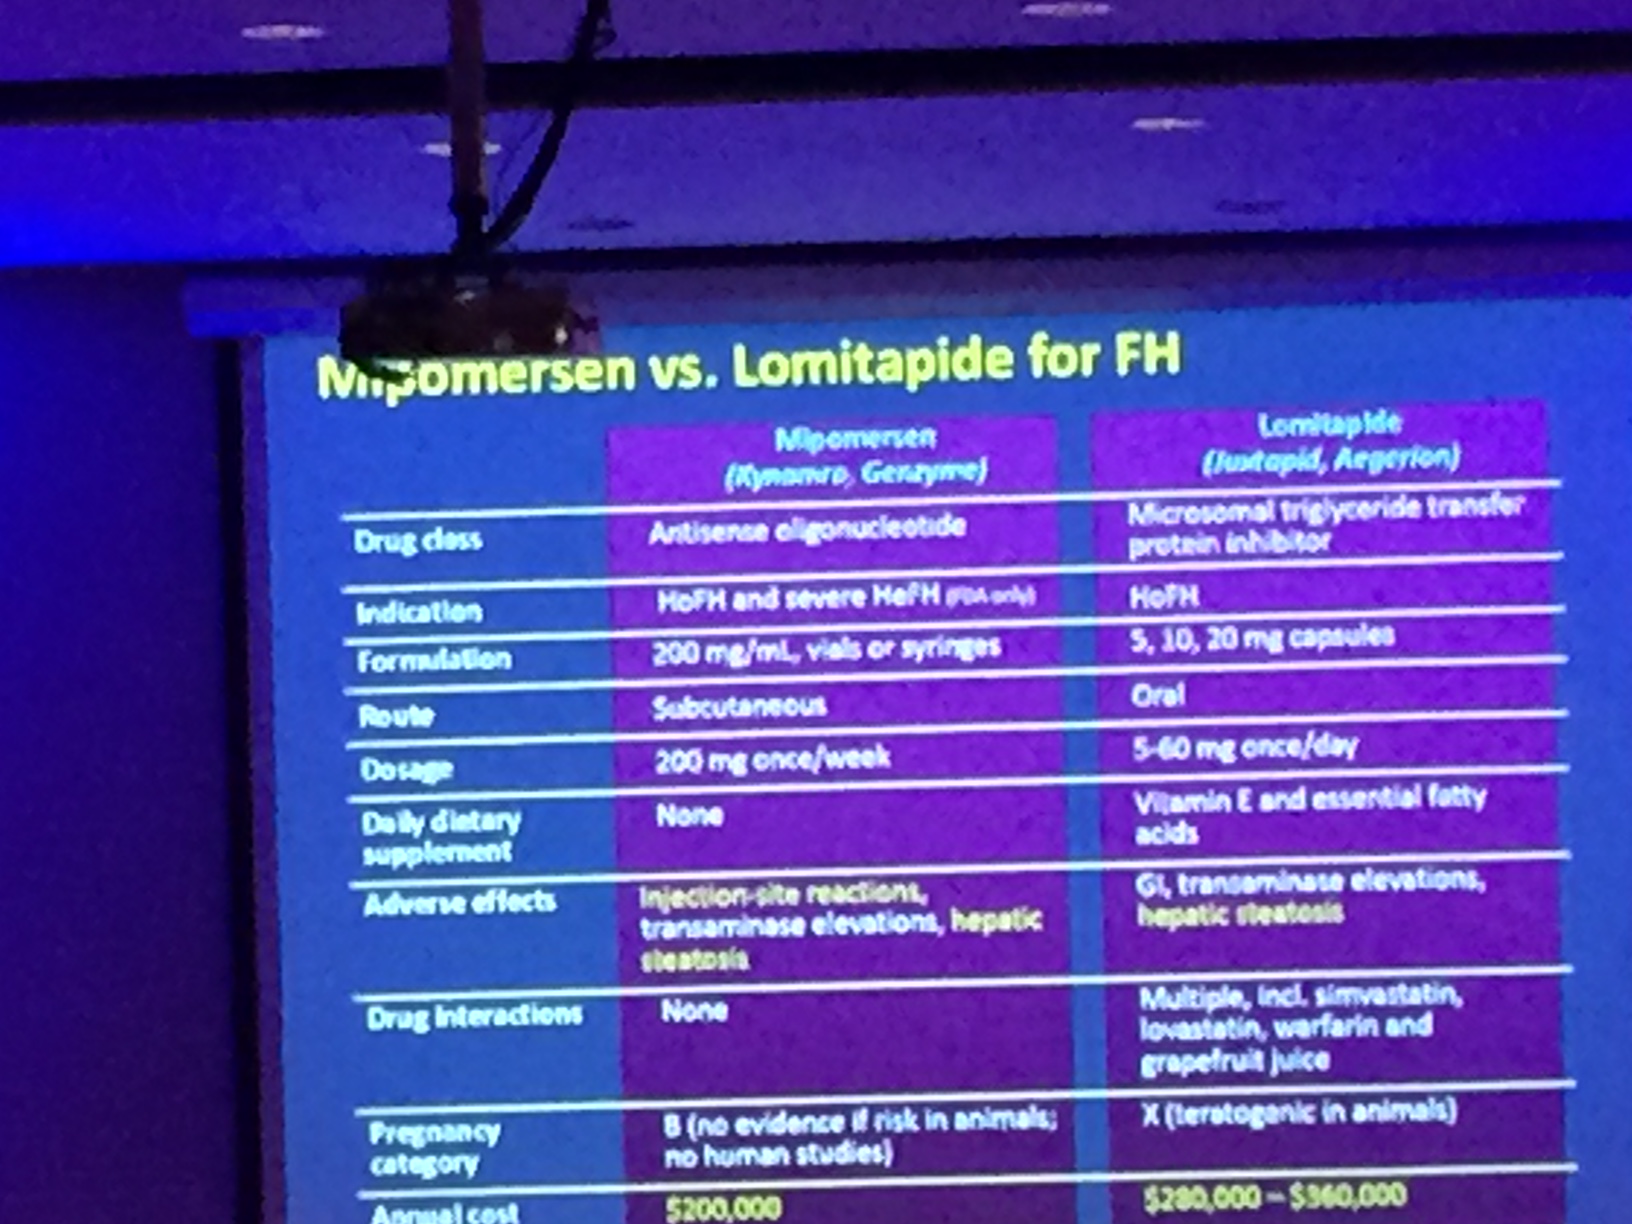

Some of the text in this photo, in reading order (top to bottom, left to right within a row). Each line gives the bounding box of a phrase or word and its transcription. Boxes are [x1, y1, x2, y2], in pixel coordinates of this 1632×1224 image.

[649, 353, 717, 390] vs.
[733, 334, 1013, 392] Lomitapide
[1028, 332, 1099, 377] for
[1115, 332, 1181, 377] FH
[1258, 410, 1403, 438] Lomitapide
[775, 427, 937, 454] Mipomersen
[861, 457, 988, 488] Genzyme)
[1334, 442, 1460, 475] Aegerion)
[1128, 490, 1526, 526] Microsomal triglyceride transfer
[354, 527, 483, 556] Drug class
[649, 514, 967, 546] Antisense oligonucleotide
[1129, 530, 1332, 560] protein inhibitor
[657, 590, 725, 613] HoFH
[733, 587, 778, 610] and
[785, 590, 866, 609] severe
[1130, 584, 1200, 609] HoFH
[356, 600, 484, 625] Indication
[653, 636, 1002, 668] 200 mg/mL, vials or syringes
[1130, 623, 1395, 654] 5, 10, 20 mg capsules
[358, 647, 512, 673] Formulation
[652, 696, 827, 721] Subcutaneous
[1131, 683, 1186, 708] Oral
[359, 704, 437, 728] Route
[656, 743, 891, 776] 200 mg once/week
[1133, 730, 1360, 763] 5-60 mg once/day
[360, 757, 454, 785] Dosage
[1133, 782, 1487, 815] Vitamin E and essential fatty
[362, 808, 522, 838] Daily dietary
[656, 803, 724, 827] None
[1135, 821, 1199, 845] acids
[363, 840, 512, 870] supplement
[807, 881, 928, 906] reactions,
[1178, 869, 1344, 896] transaminase
[1351, 867, 1486, 894] elevations,
[364, 888, 557, 917] Adverse effects
[1137, 900, 1345, 932] hepatic steatosis
[640, 906, 1044, 940] transaminase elevations, hepatic
[641, 947, 749, 973] steatosis
[661, 999, 728, 1023] None
[1140, 981, 1463, 1013] Multiple, incl. simvastatin,
[367, 1005, 430, 1034] Drug
[1140, 1010, 1434, 1042] lovastatin, warfarin and
[1140, 1047, 1331, 1078] grapefruit juice
[687, 1112, 729, 1142] (no
[735, 1109, 844, 1136] evidence
[874, 1107, 920, 1132] risk
[924, 1107, 949, 1131] in
[1142, 1102, 1160, 1127] X
[1322, 1099, 1345, 1123] in
[1352, 1096, 1457, 1125] animals)
[369, 1120, 501, 1149] Pregnancy
[369, 1152, 480, 1181] category
[664, 1137, 895, 1169] no human studies)
[666, 1195, 783, 1224] $200,000
